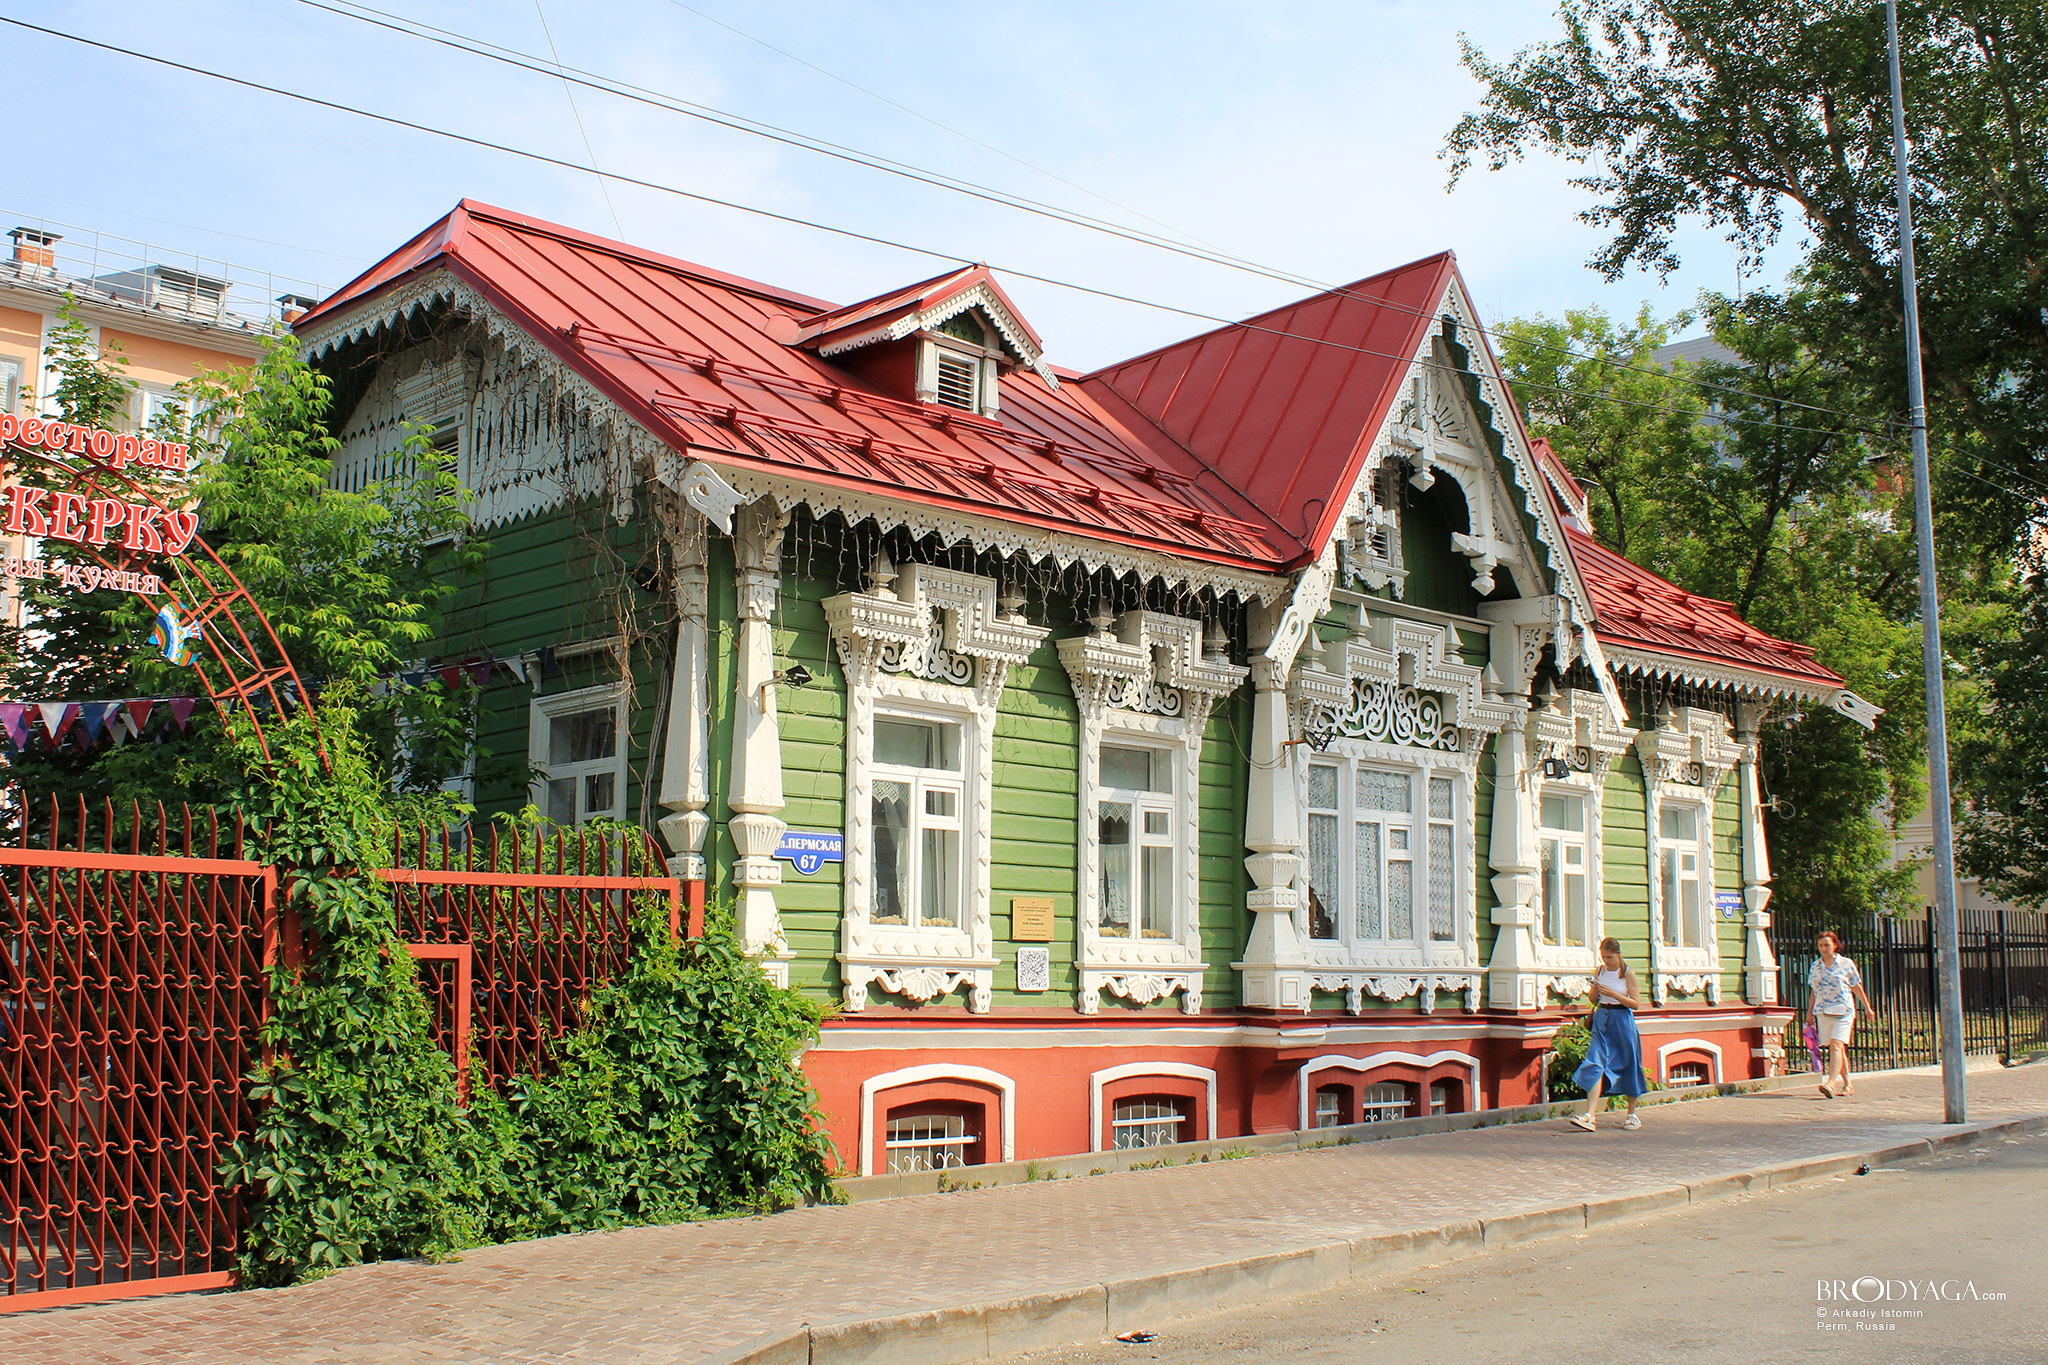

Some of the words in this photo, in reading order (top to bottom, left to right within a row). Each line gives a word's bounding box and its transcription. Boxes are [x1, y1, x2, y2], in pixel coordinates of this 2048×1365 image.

[0, 412, 190, 471] ресторан
[4, 484, 201, 556] КЕРКУ
[0, 554, 46, 580] ая
[63, 561, 161, 595] кухня
[800, 854, 818, 870] 67
